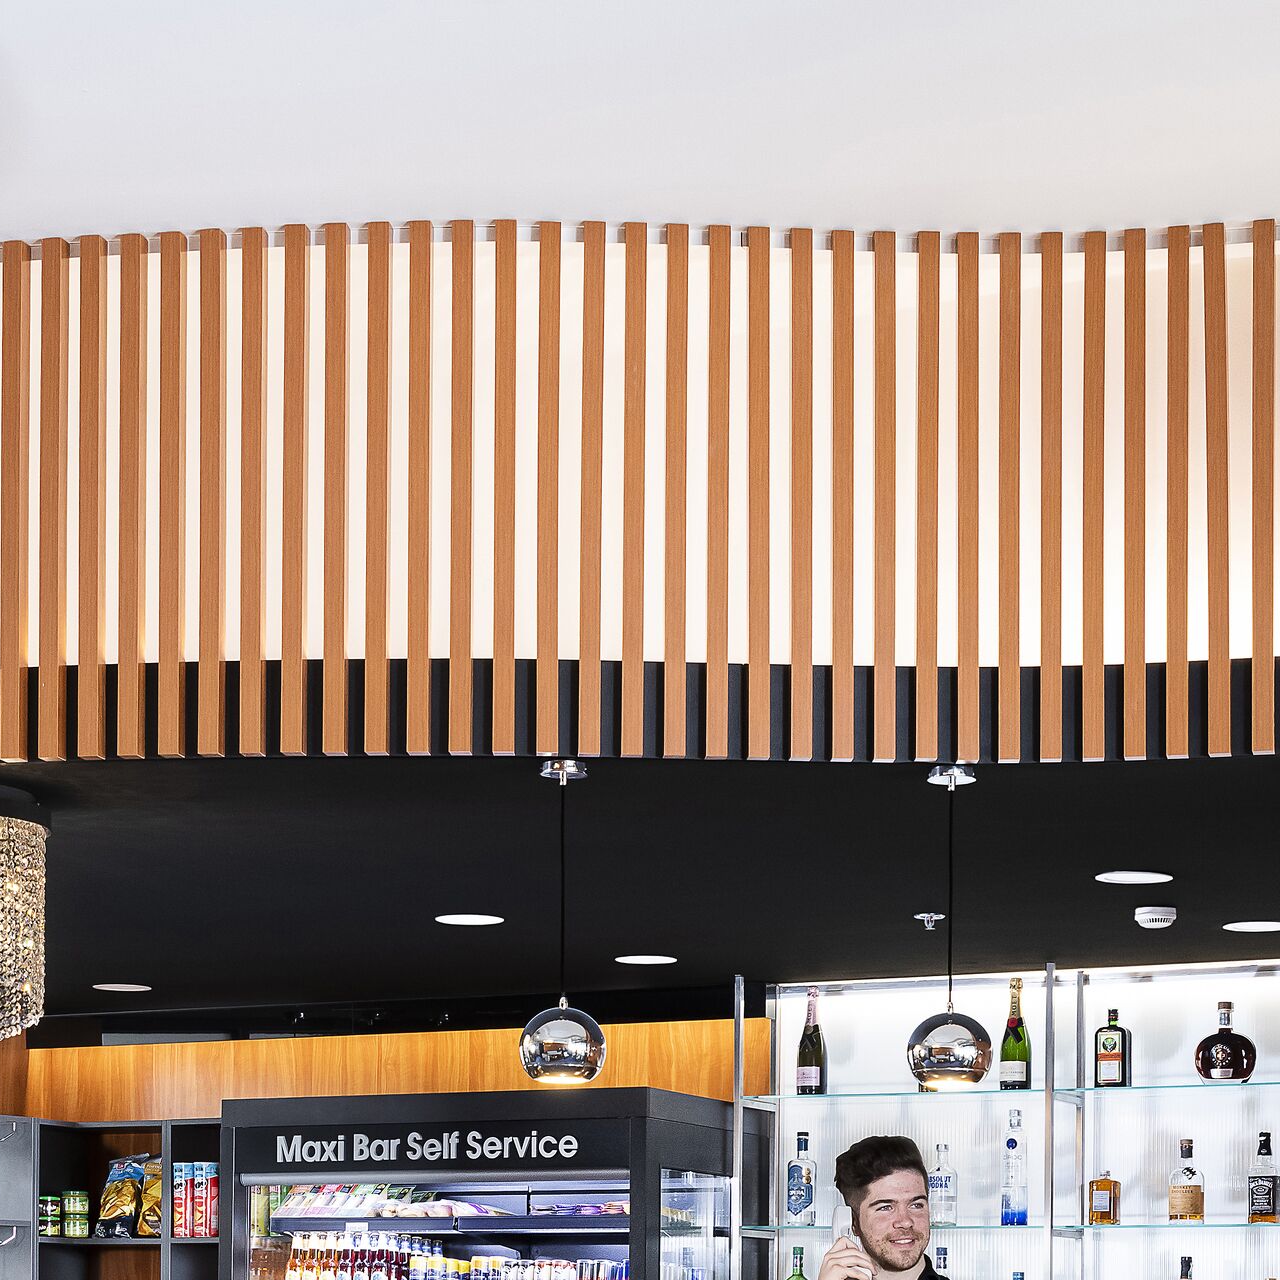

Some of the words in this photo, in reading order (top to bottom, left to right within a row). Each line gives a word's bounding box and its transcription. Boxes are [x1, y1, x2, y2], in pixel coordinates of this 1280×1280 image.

[276, 1135, 345, 1163] Maxi
[353, 1134, 400, 1161] Bar
[406, 1131, 459, 1160] Self
[466, 1131, 578, 1159] Service
